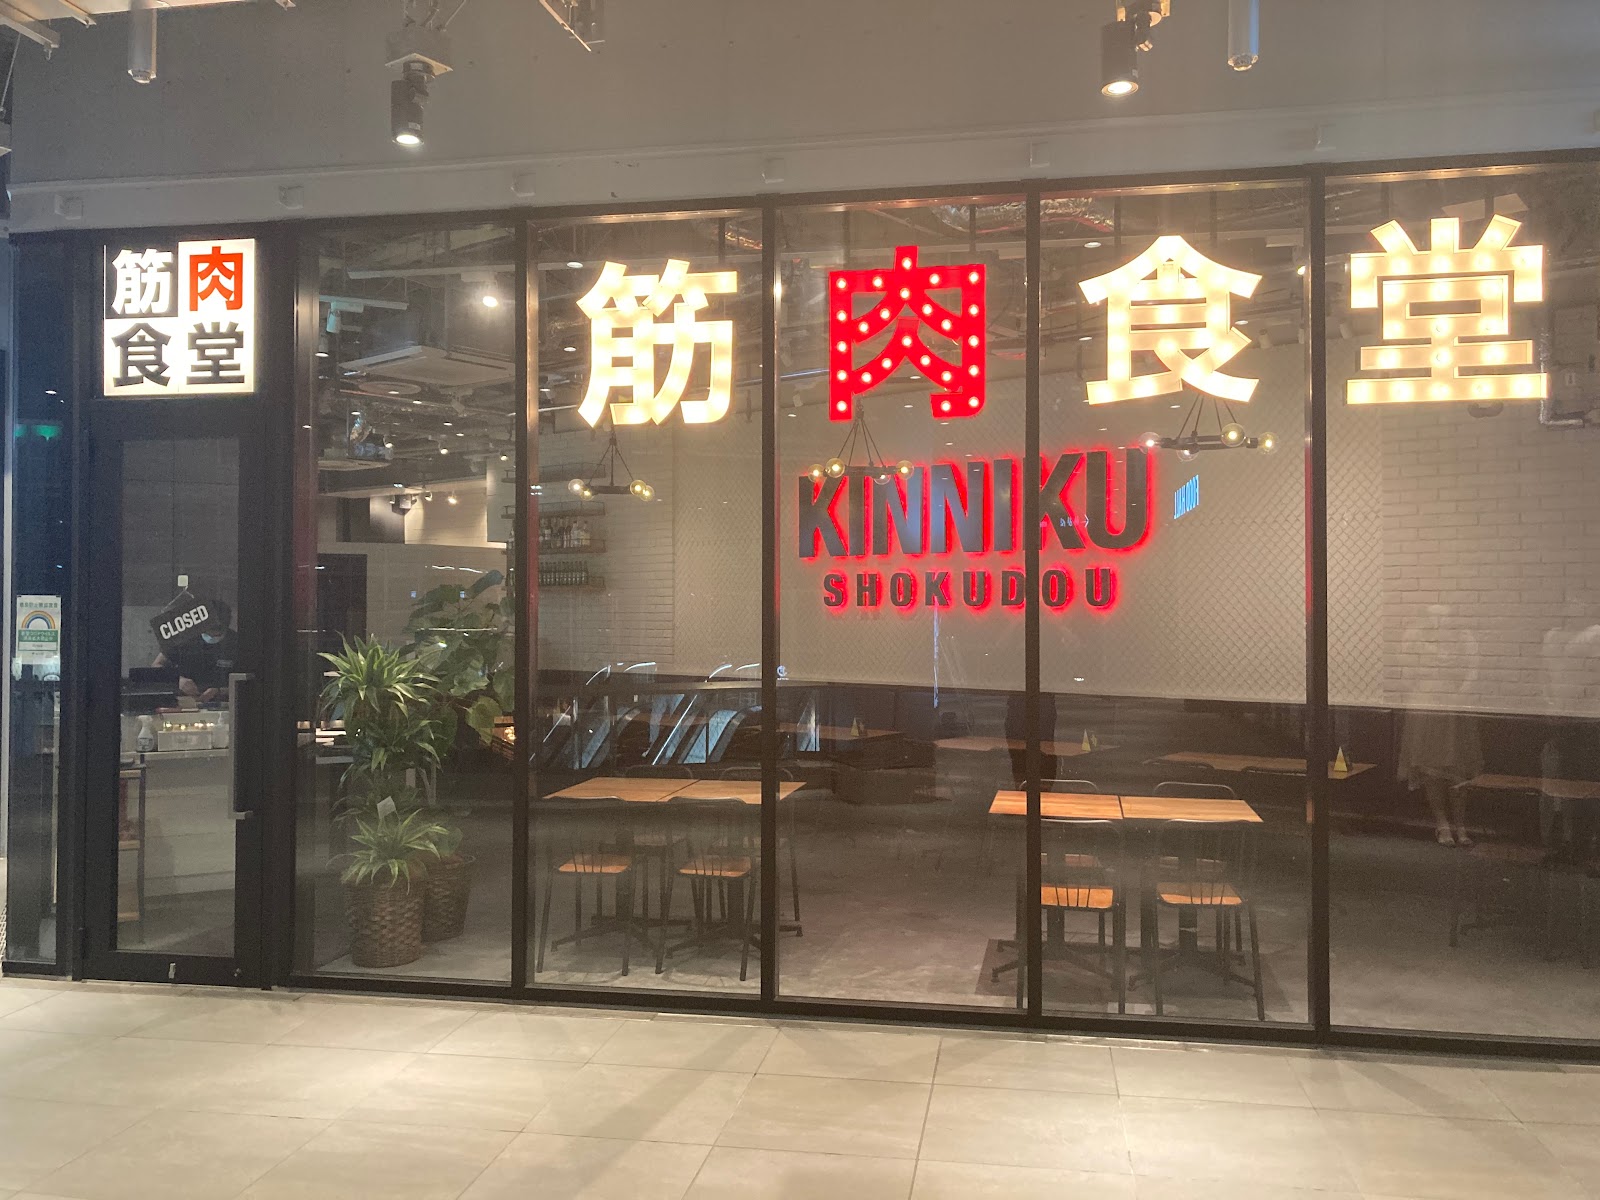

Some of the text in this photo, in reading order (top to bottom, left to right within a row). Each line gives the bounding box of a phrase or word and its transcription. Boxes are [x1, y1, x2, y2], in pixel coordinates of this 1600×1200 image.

[111, 246, 244, 315] 筋肉
[111, 321, 245, 387] 食堂
[576, 214, 1548, 427] 筋肉食堂
[799, 448, 1149, 558] KINNIKU
[823, 568, 1112, 607] SHOKUDOU
[160, 605, 209, 640] CLOSED
